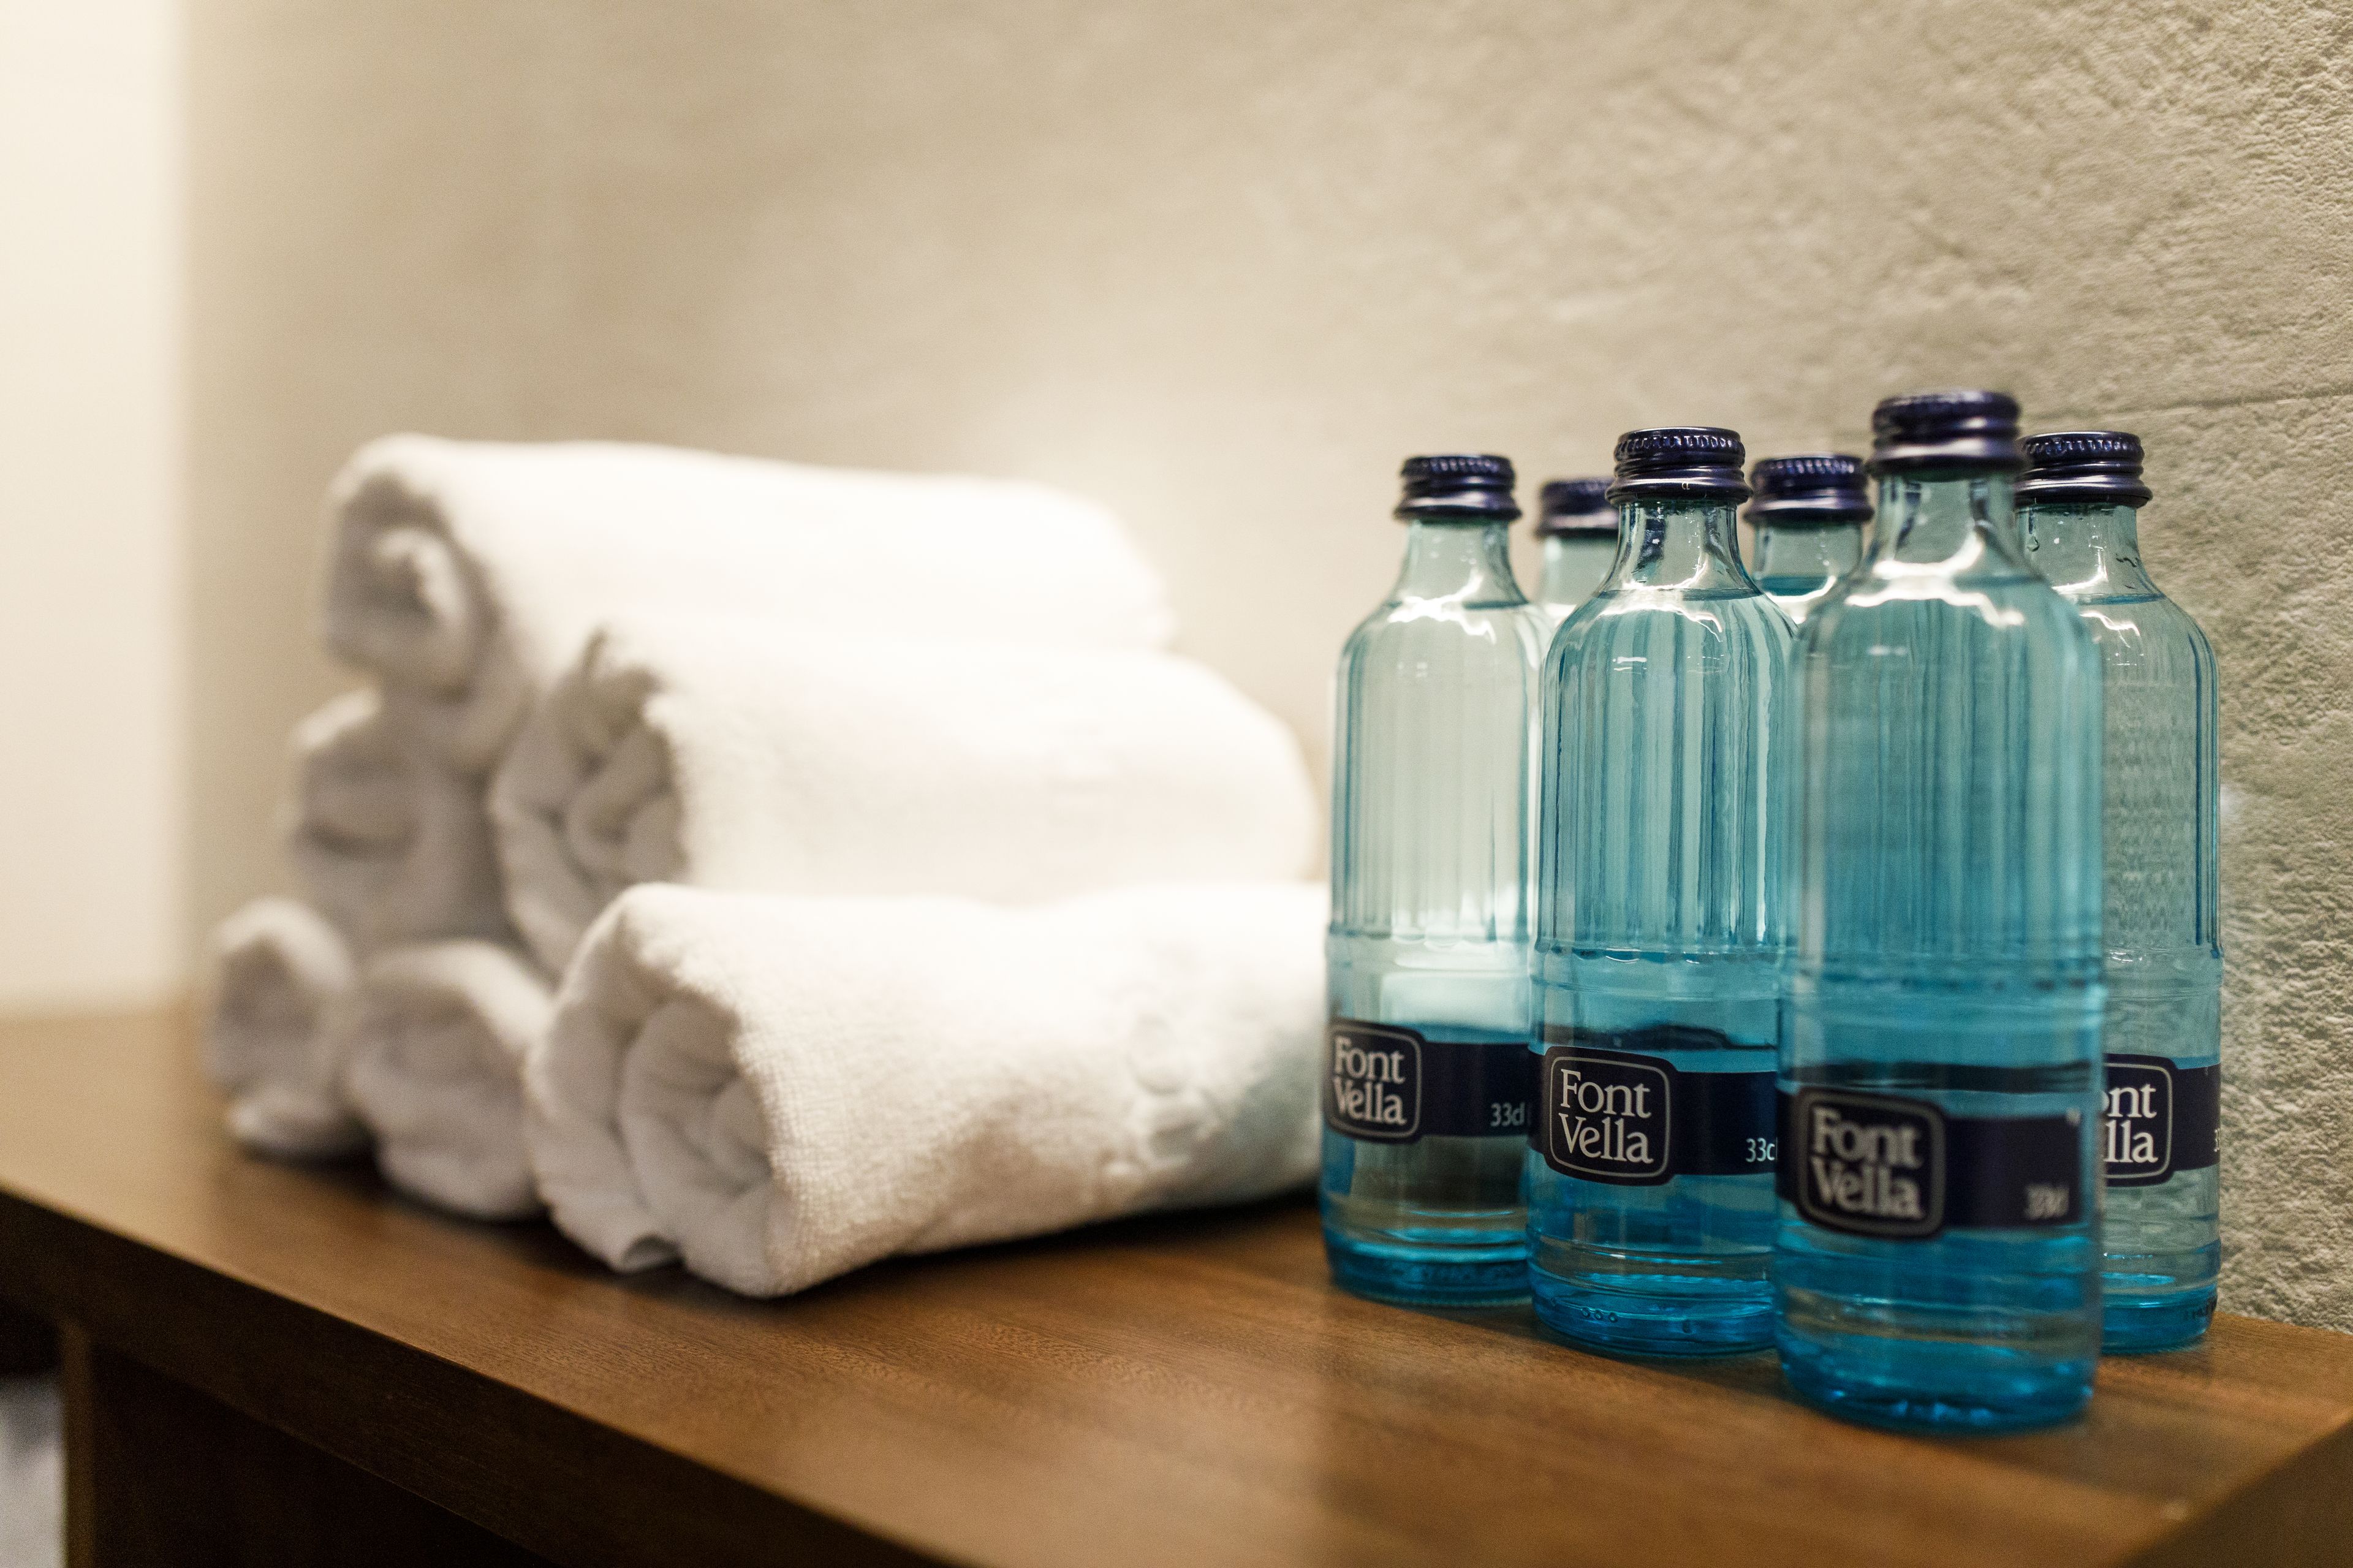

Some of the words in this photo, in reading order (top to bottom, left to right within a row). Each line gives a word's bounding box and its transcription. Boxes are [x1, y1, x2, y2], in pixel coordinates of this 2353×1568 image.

[1333, 1036, 1406, 1084] Font
[1333, 1076, 1407, 1126] Vella
[1560, 1069, 1651, 1118] Font
[2101, 1083, 2157, 1118] nt
[1558, 1112, 1654, 1164] Vella
[1812, 1107, 1925, 1169] Font
[2103, 1119, 2158, 1163] lla
[1811, 1156, 1925, 1221] Vella
